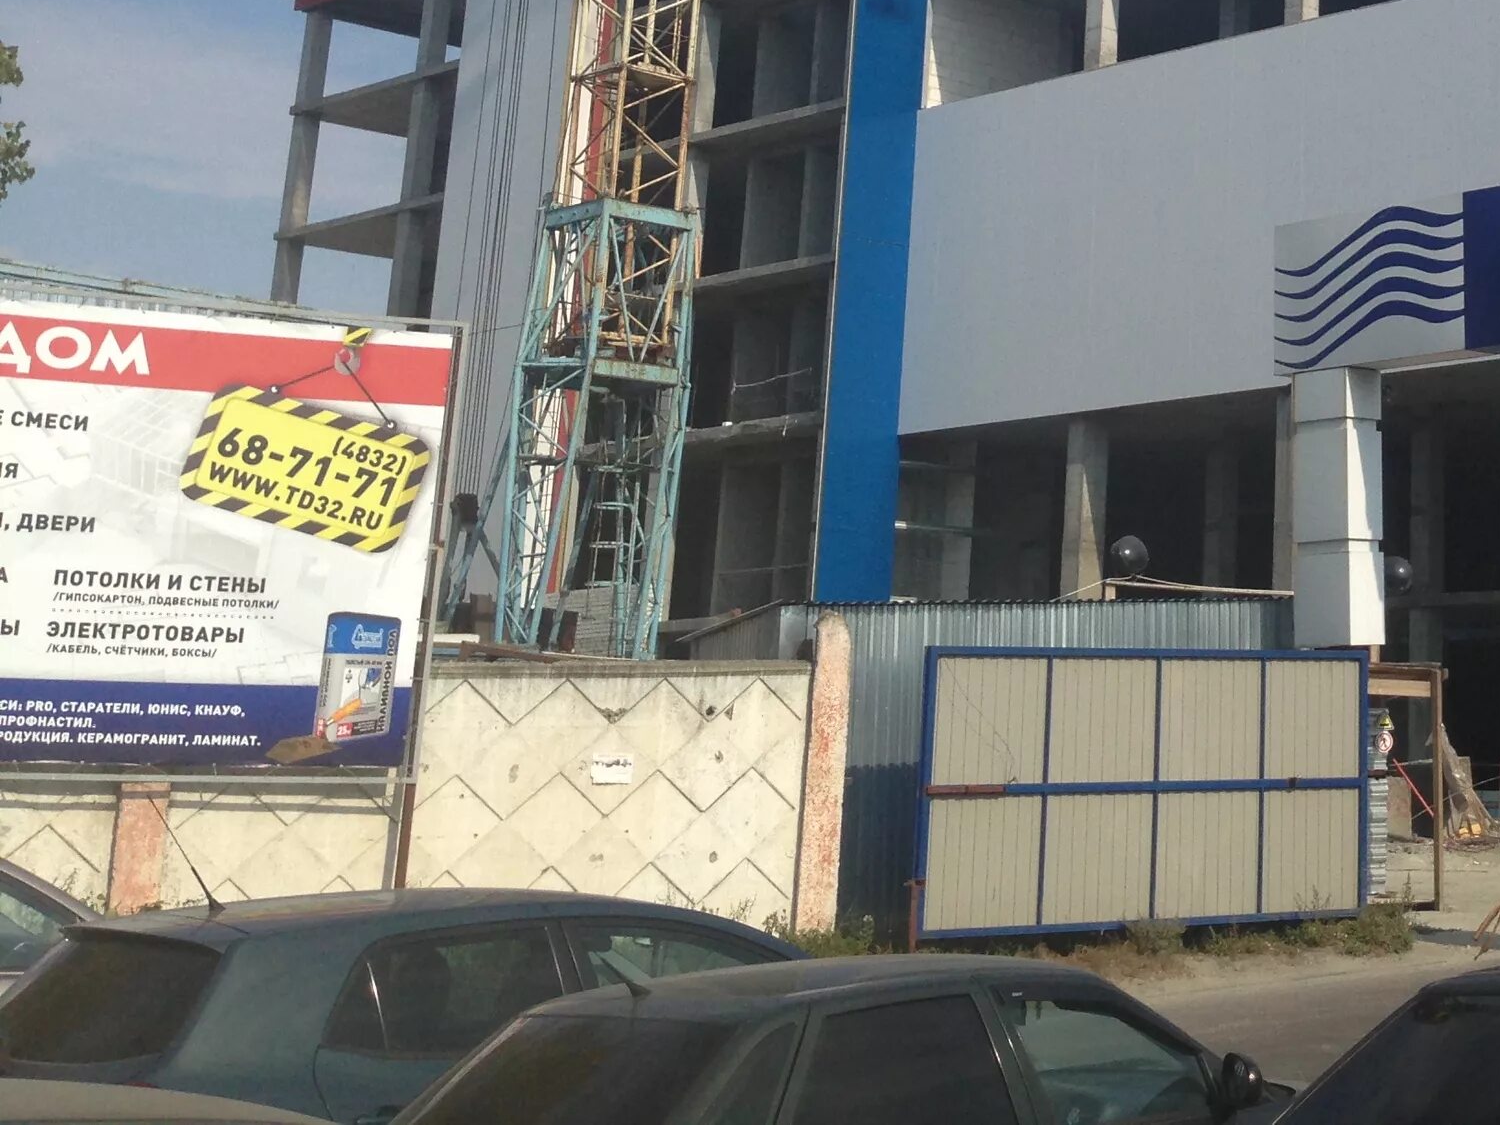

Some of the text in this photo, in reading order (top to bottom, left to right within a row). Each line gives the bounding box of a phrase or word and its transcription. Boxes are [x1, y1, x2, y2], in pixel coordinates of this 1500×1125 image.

[11, 410, 89, 432] СМЕСИ
[217, 427, 397, 507] 68-71-71
[332, 436, 407, 476] (4832)
[209, 461, 383, 530] WWW.TD32.RU
[16, 513, 96, 533] ДВЕРИ
[53, 569, 266, 594] ПОТОЛКИ И СТЕНЫ
[149, 596, 219, 607] ПОДВЕСНЫЕ
[222, 598, 280, 610] ПОТОЛКИ/
[46, 621, 245, 644] ЭЛЕКТРОТОВАРЫ
[172, 648, 217, 659] БОКСЫ/
[26, 700, 57, 714] PRO,
[60, 701, 144, 716] СТАРАТЕЛИ,
[147, 704, 191, 717] ЮНИС,
[77, 732, 189, 747] КЕРАМОГРАНИТ,
[192, 734, 261, 746] ЛАМИНАТ.
